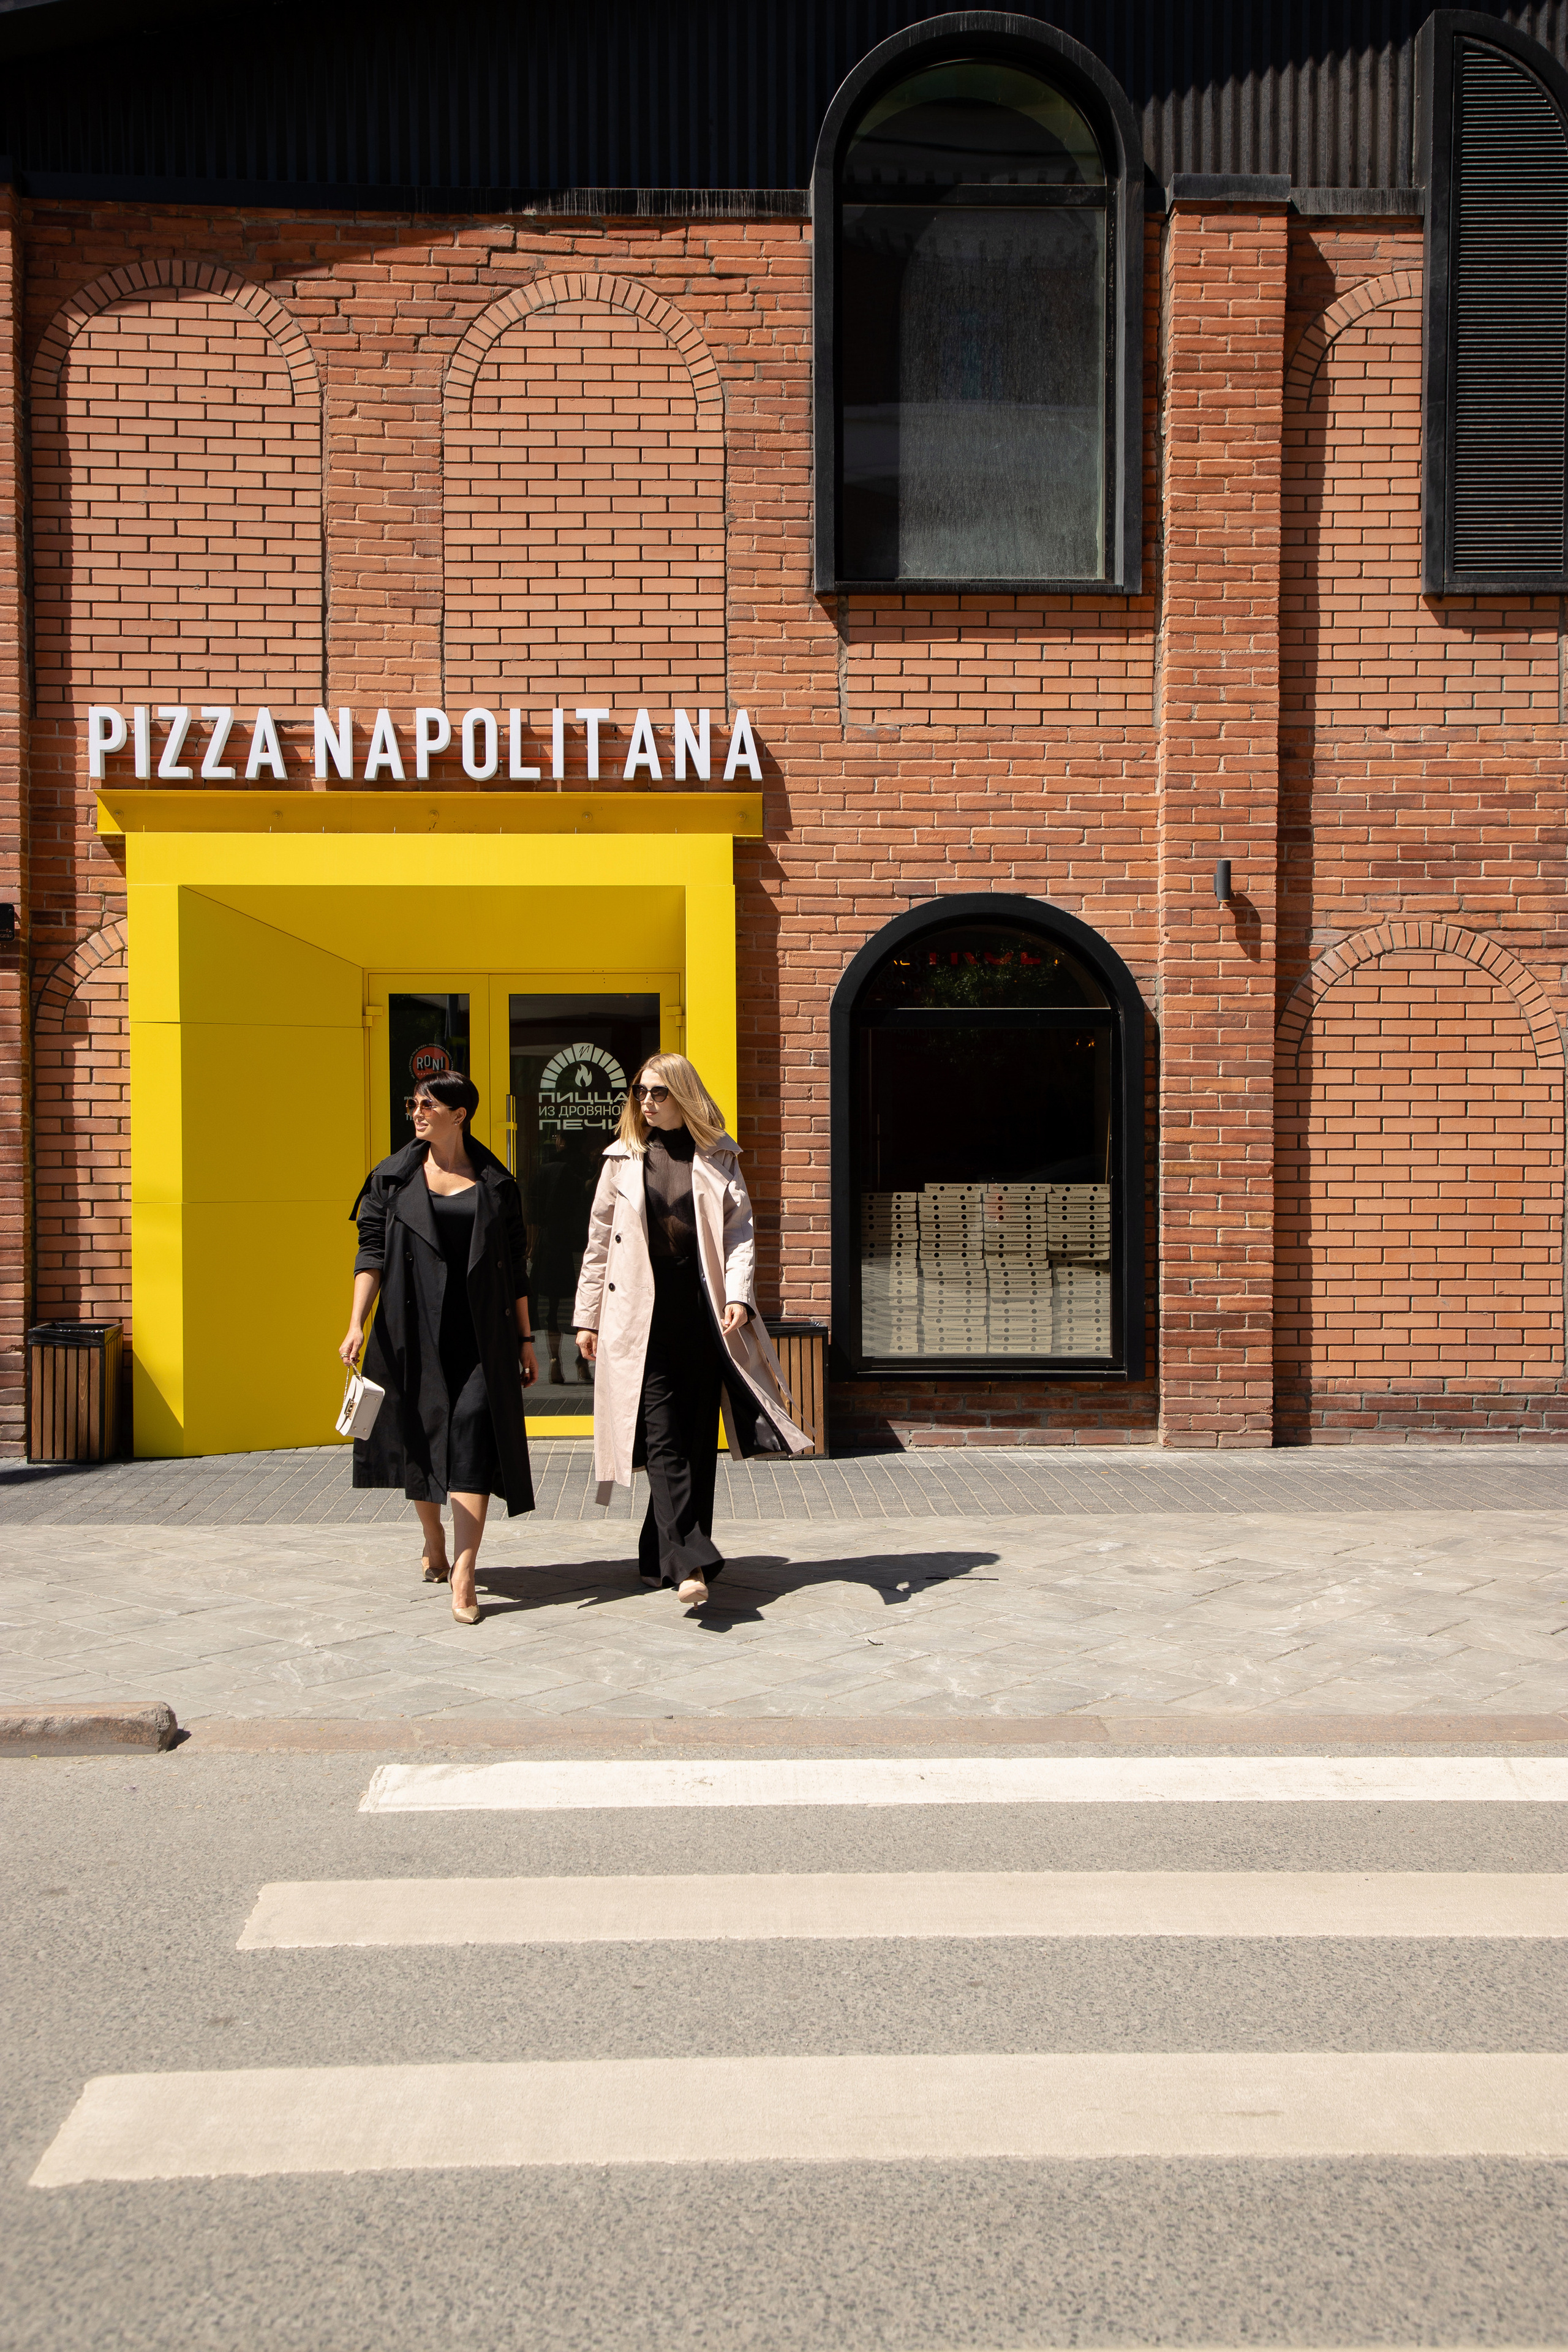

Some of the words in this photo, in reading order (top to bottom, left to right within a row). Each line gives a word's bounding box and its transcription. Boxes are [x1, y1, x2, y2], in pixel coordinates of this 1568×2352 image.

[89, 706, 288, 780] PIZZA
[314, 707, 763, 782] NAPOLITANA
[417, 1055, 443, 1071] RONI
[538, 1092, 628, 1105] ПИЦЦА
[539, 1106, 555, 1116] ИЗ
